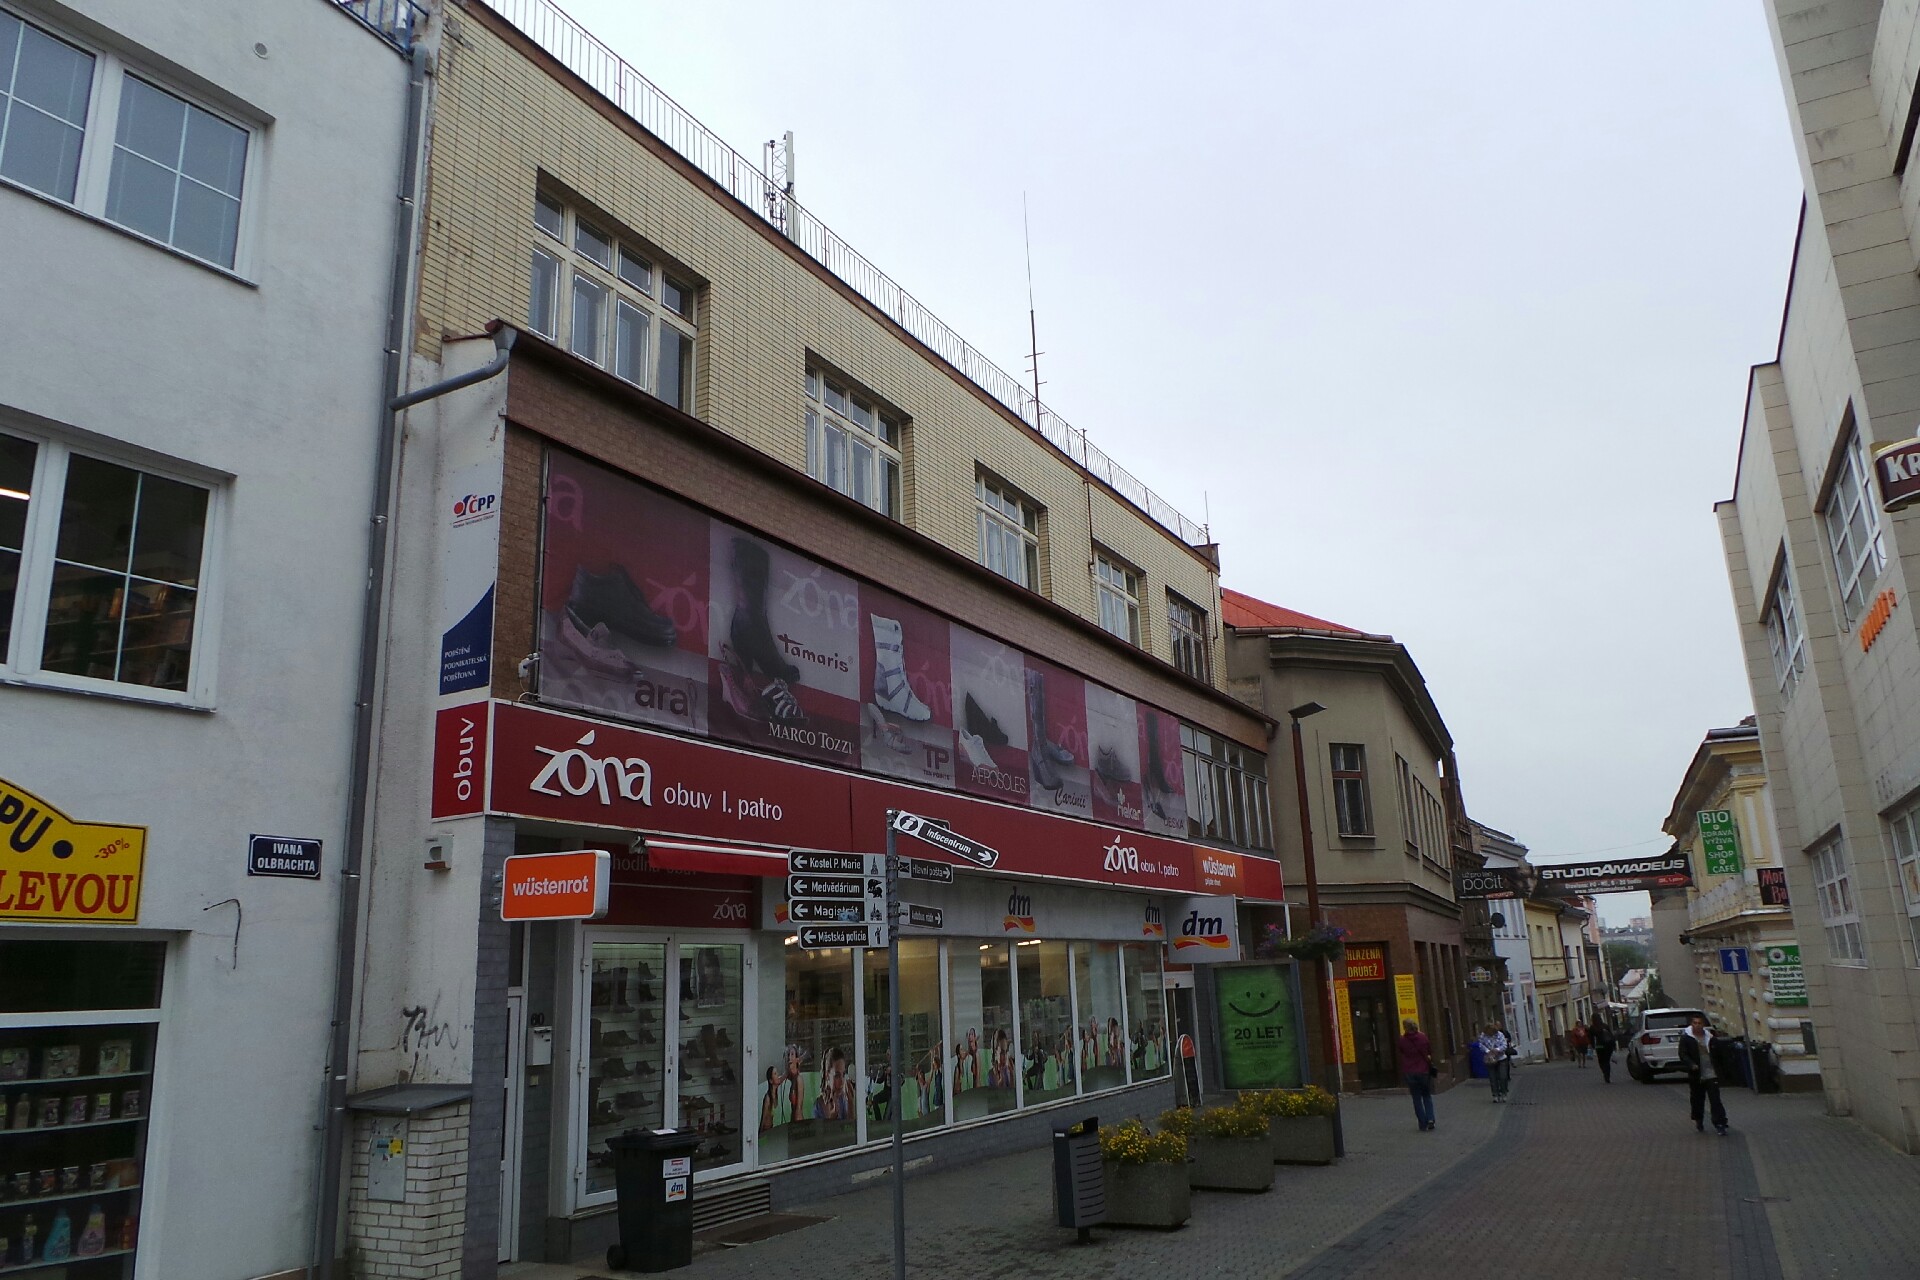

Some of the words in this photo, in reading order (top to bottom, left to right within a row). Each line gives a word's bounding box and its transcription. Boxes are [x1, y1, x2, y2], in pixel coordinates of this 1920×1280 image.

[468, 494, 495, 514] ČPP
[635, 680, 689, 718] ara
[768, 722, 816, 746] MARCO
[818, 732, 853, 755] TOZZI
[453, 717, 476, 801] obuv
[923, 743, 949, 770] TP
[530, 729, 652, 806] zóna
[663, 783, 712, 811] obuv
[738, 797, 783, 822] patro
[971, 767, 1027, 794] AEROSOLES
[0, 790, 54, 853] PU
[1702, 811, 1729, 824] BIO
[273, 843, 303, 856] IVANA
[926, 828, 972, 854] Infocentrum
[257, 857, 316, 872] OLBRACHTA
[809, 858, 833, 869] Kostel
[833, 858, 839, 869] P.
[841, 858, 861, 869] Marie
[1103, 835, 1138, 873] zóna
[1141, 860, 1156, 873] obuv
[1164, 864, 1180, 878] patro
[1709, 850, 1734, 859] SHOP
[1202, 857, 1237, 878] wüstenrot
[1542, 859, 1685, 880] STUDIOAMADEUS
[1712, 864, 1736, 873] CAFÉ
[513, 876, 589, 896] wüstenrot
[811, 881, 860, 894] Medvědárium
[1462, 874, 1504, 893] pocit
[713, 898, 747, 921] zóna
[1008, 886, 1031, 915] dm
[1182, 910, 1222, 935] dm
[818, 931, 845, 943] Městská
[846, 930, 867, 944] policie
[1234, 1029, 1251, 1040] 20
[1257, 1026, 1284, 1039] LET
[671, 1182, 684, 1192] dm
